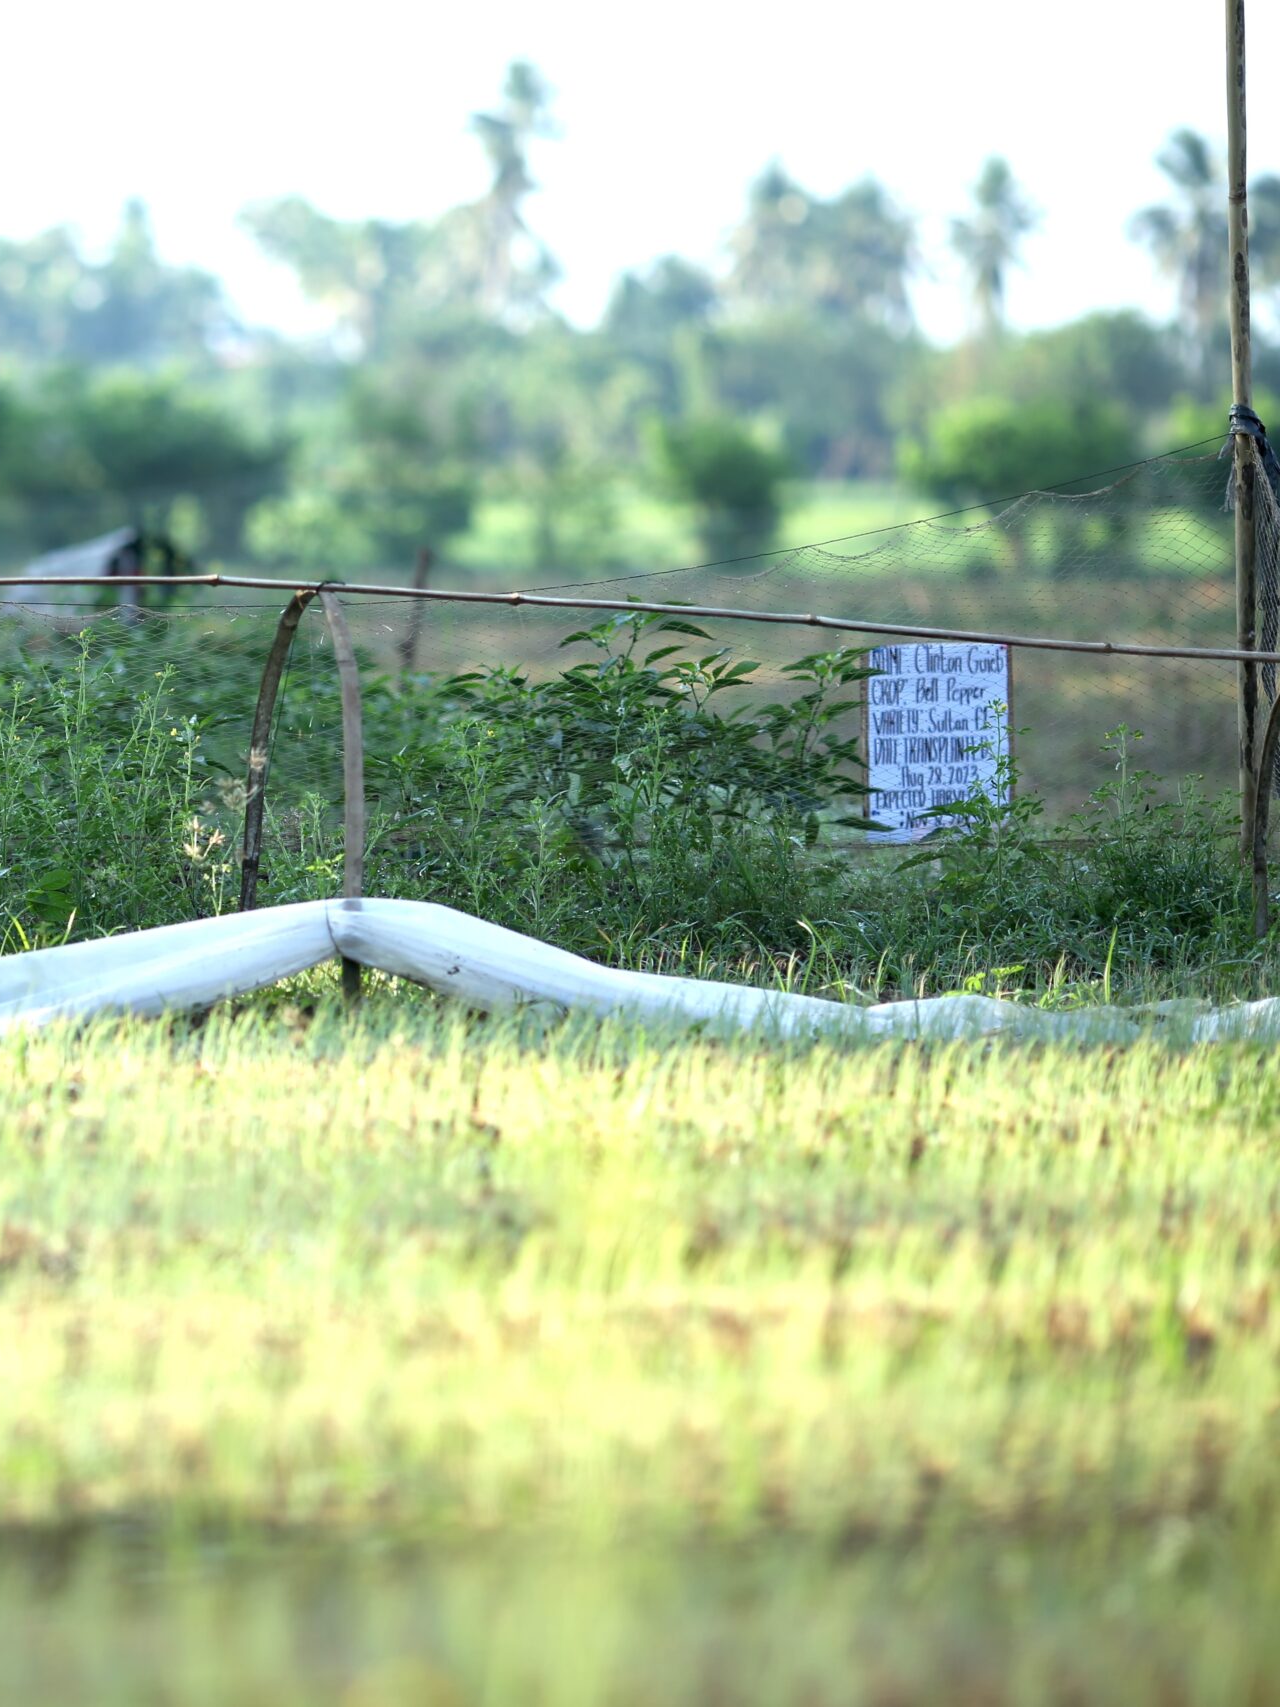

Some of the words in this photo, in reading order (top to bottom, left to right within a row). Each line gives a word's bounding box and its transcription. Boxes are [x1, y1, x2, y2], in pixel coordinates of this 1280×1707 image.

[915, 644, 962, 674] Clinton
[916, 678, 939, 703] Bell
[947, 678, 985, 705] Pepper
[928, 707, 969, 733] Sultan
[874, 737, 898, 765] DATE
[901, 765, 924, 794] Aug
[948, 765, 980, 785] 2023
[875, 789, 926, 809] EXPECTED
